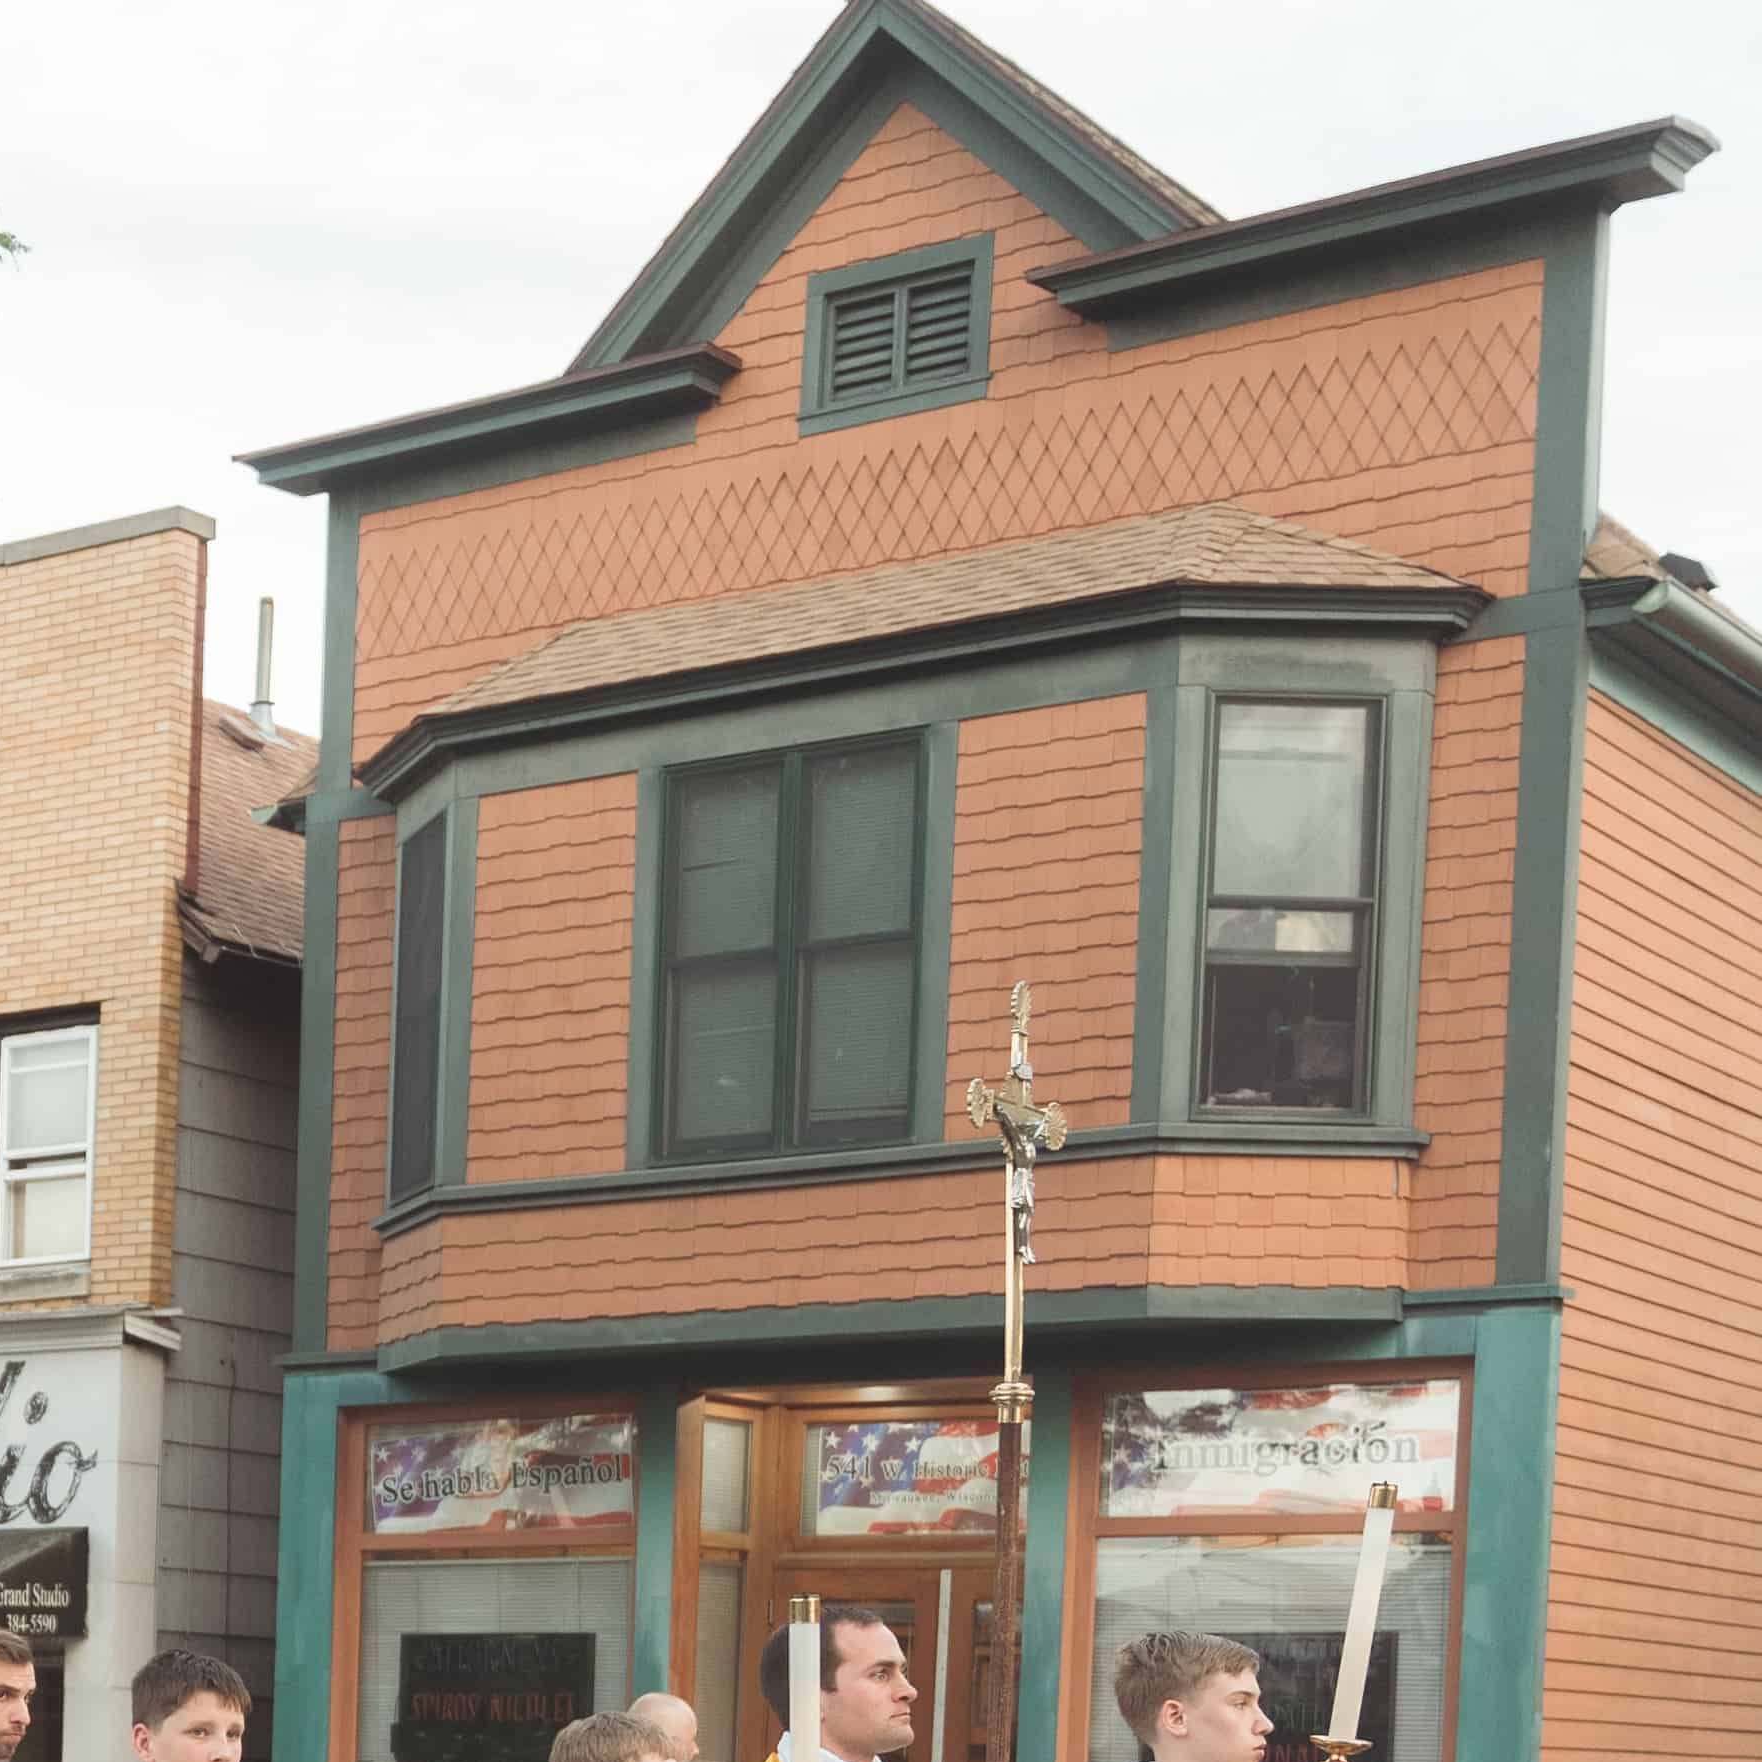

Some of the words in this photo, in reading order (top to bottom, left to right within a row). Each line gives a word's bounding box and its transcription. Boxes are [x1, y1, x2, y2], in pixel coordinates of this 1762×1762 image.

[1155, 1421, 1420, 1474] Inmigración
[382, 1477, 414, 1503] Se
[424, 1467, 500, 1499] habla
[510, 1453, 623, 1494] Español
[826, 1454, 872, 1481] 541
[913, 1458, 988, 1480] Historic
[31, 1582, 70, 1608] Studio
